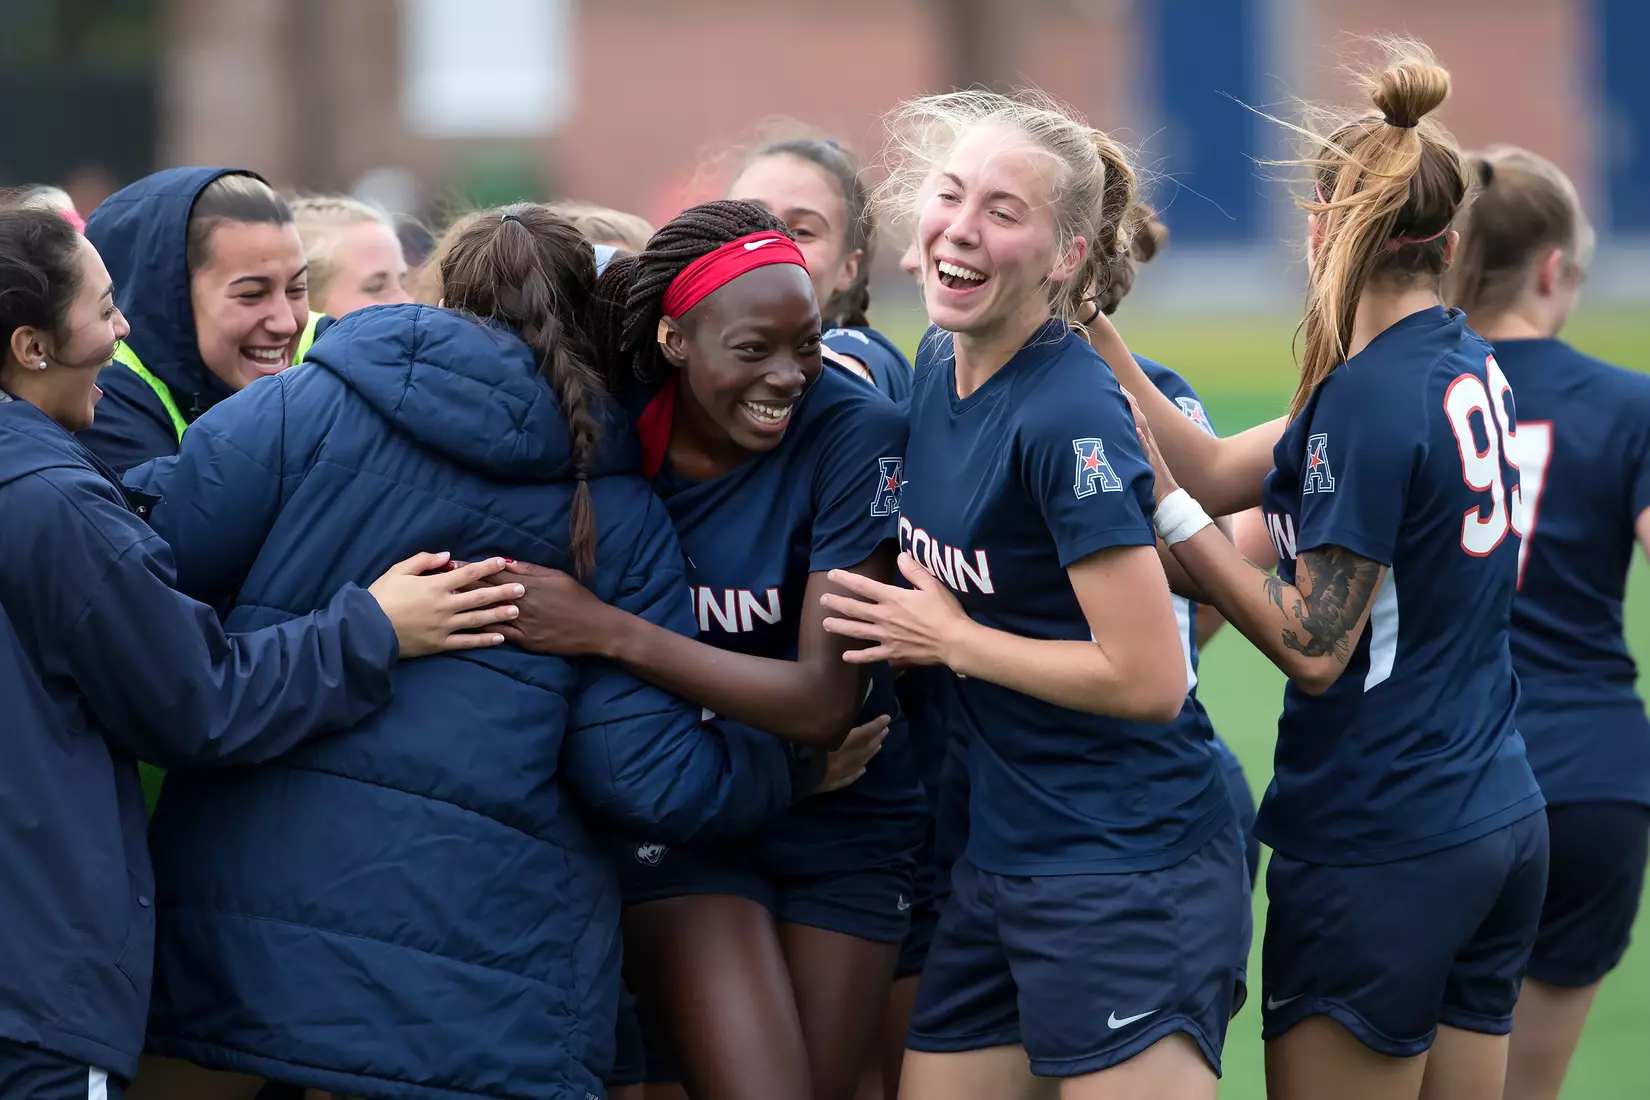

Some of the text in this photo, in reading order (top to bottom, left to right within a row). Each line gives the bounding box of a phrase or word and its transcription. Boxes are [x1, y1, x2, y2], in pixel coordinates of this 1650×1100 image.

[1072, 437, 1123, 499] A
[1303, 432, 1335, 495] A
[1443, 354, 1522, 557] 99
[688, 585, 782, 633] NN
